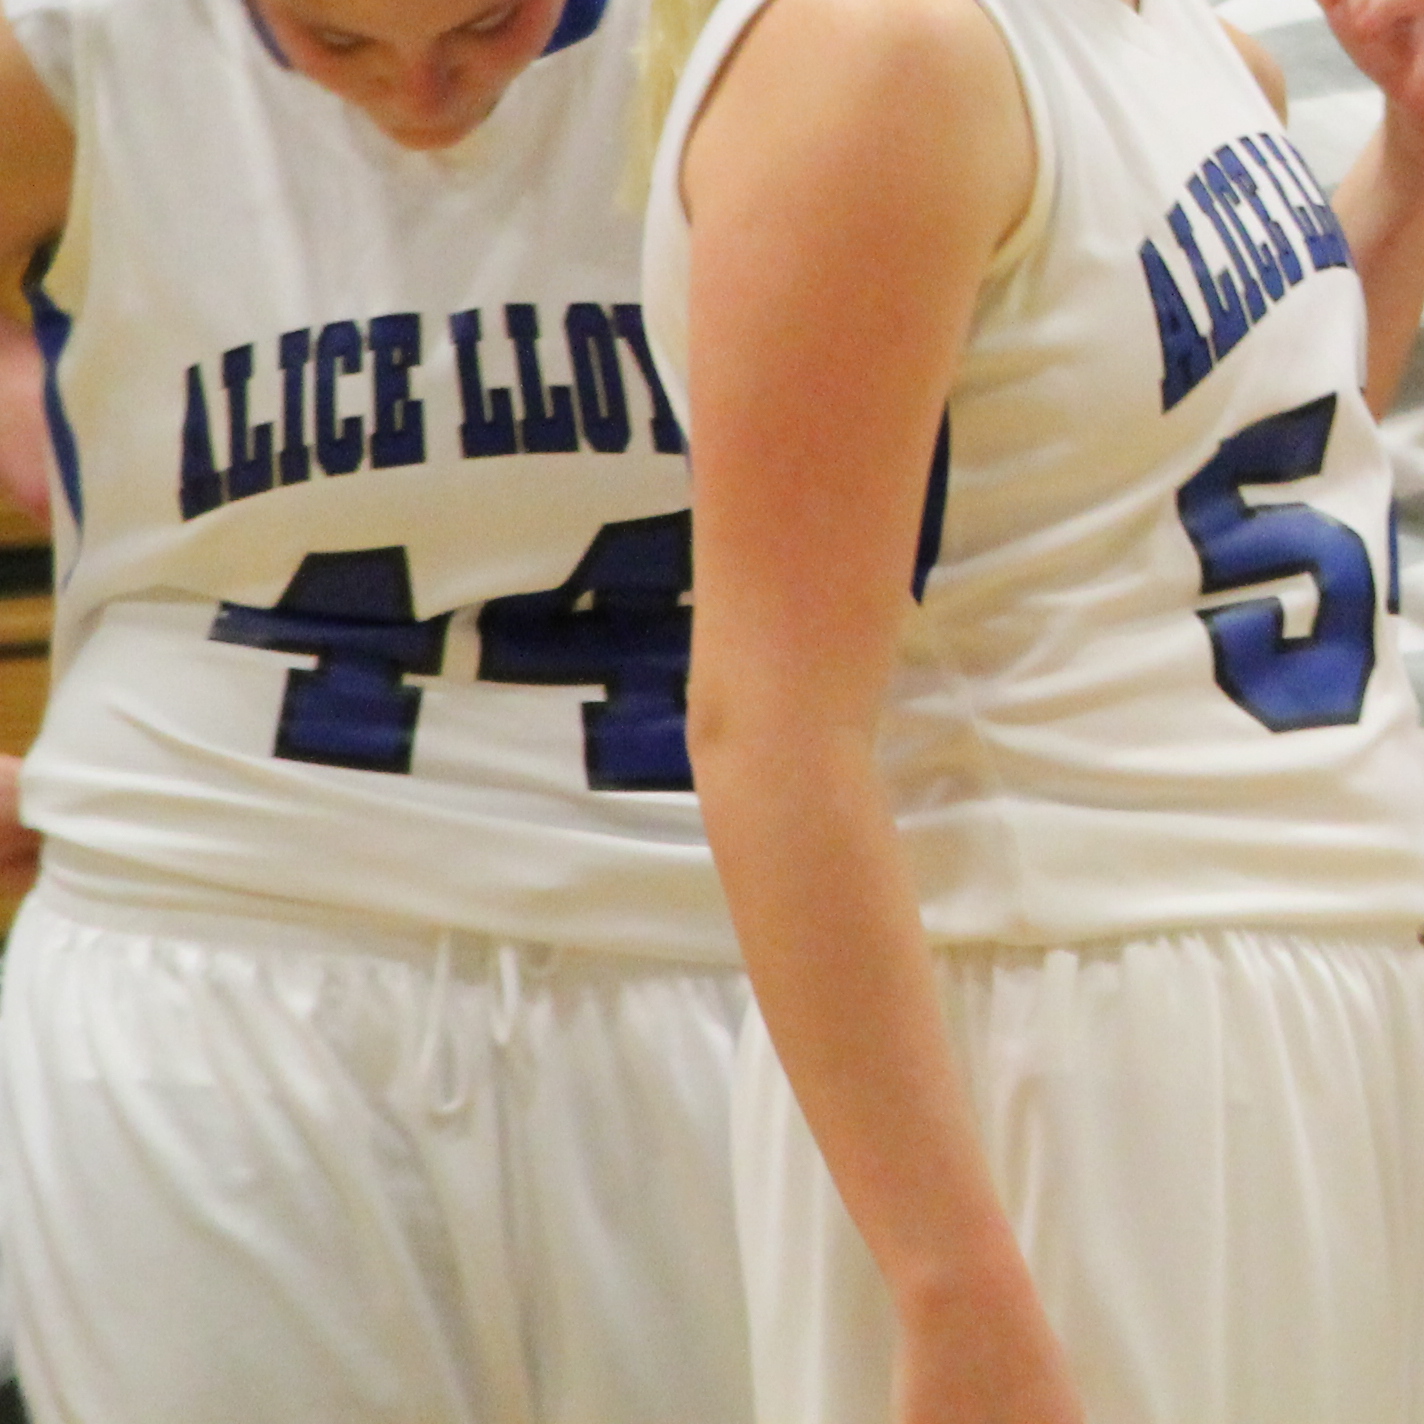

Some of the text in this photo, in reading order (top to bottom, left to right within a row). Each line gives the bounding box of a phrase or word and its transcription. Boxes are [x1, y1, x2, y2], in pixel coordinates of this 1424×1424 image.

[178, 312, 427, 522] ALICE
[1138, 144, 1305, 416] ALICE
[208, 508, 694, 792] 44
[1176, 390, 1400, 733] 5
